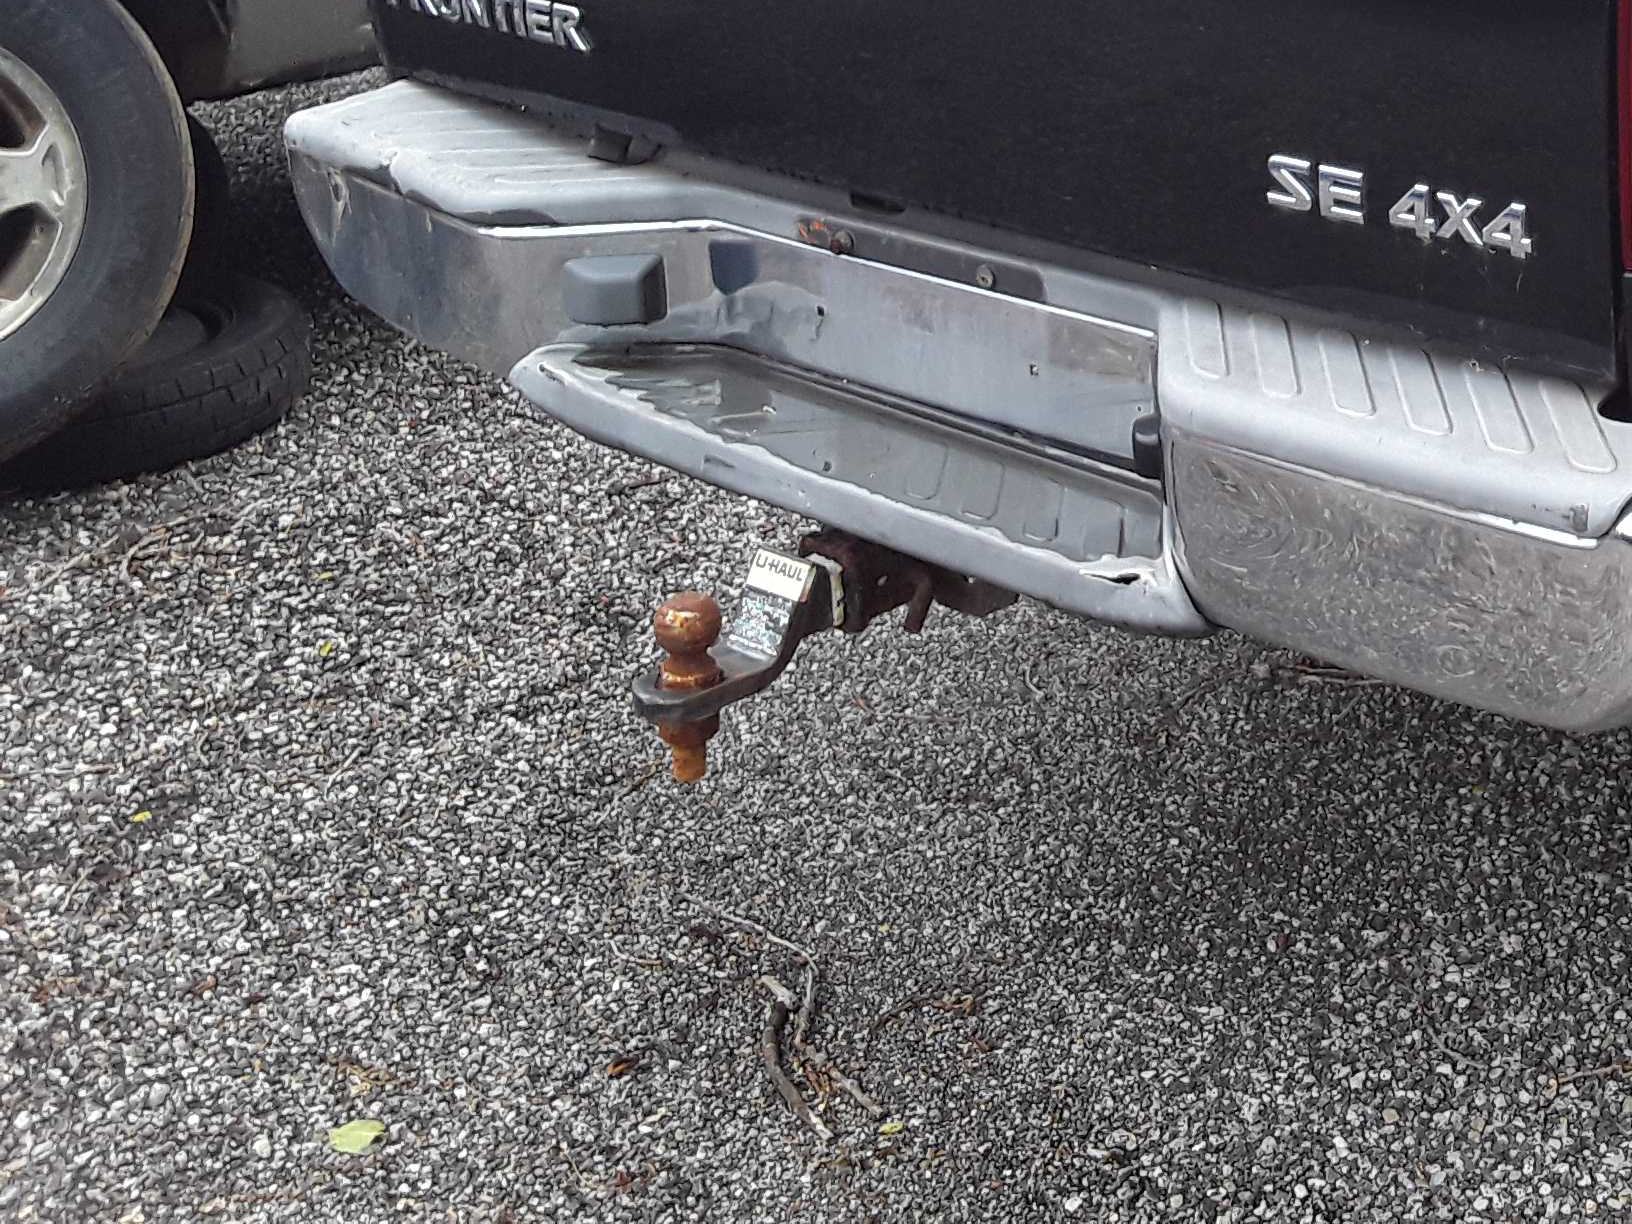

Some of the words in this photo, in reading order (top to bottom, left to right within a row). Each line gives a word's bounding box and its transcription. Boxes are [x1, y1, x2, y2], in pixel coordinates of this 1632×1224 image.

[1266, 154, 1365, 224] SE
[1388, 183, 1532, 260] 4X4
[755, 554, 803, 582] U-HAUL
